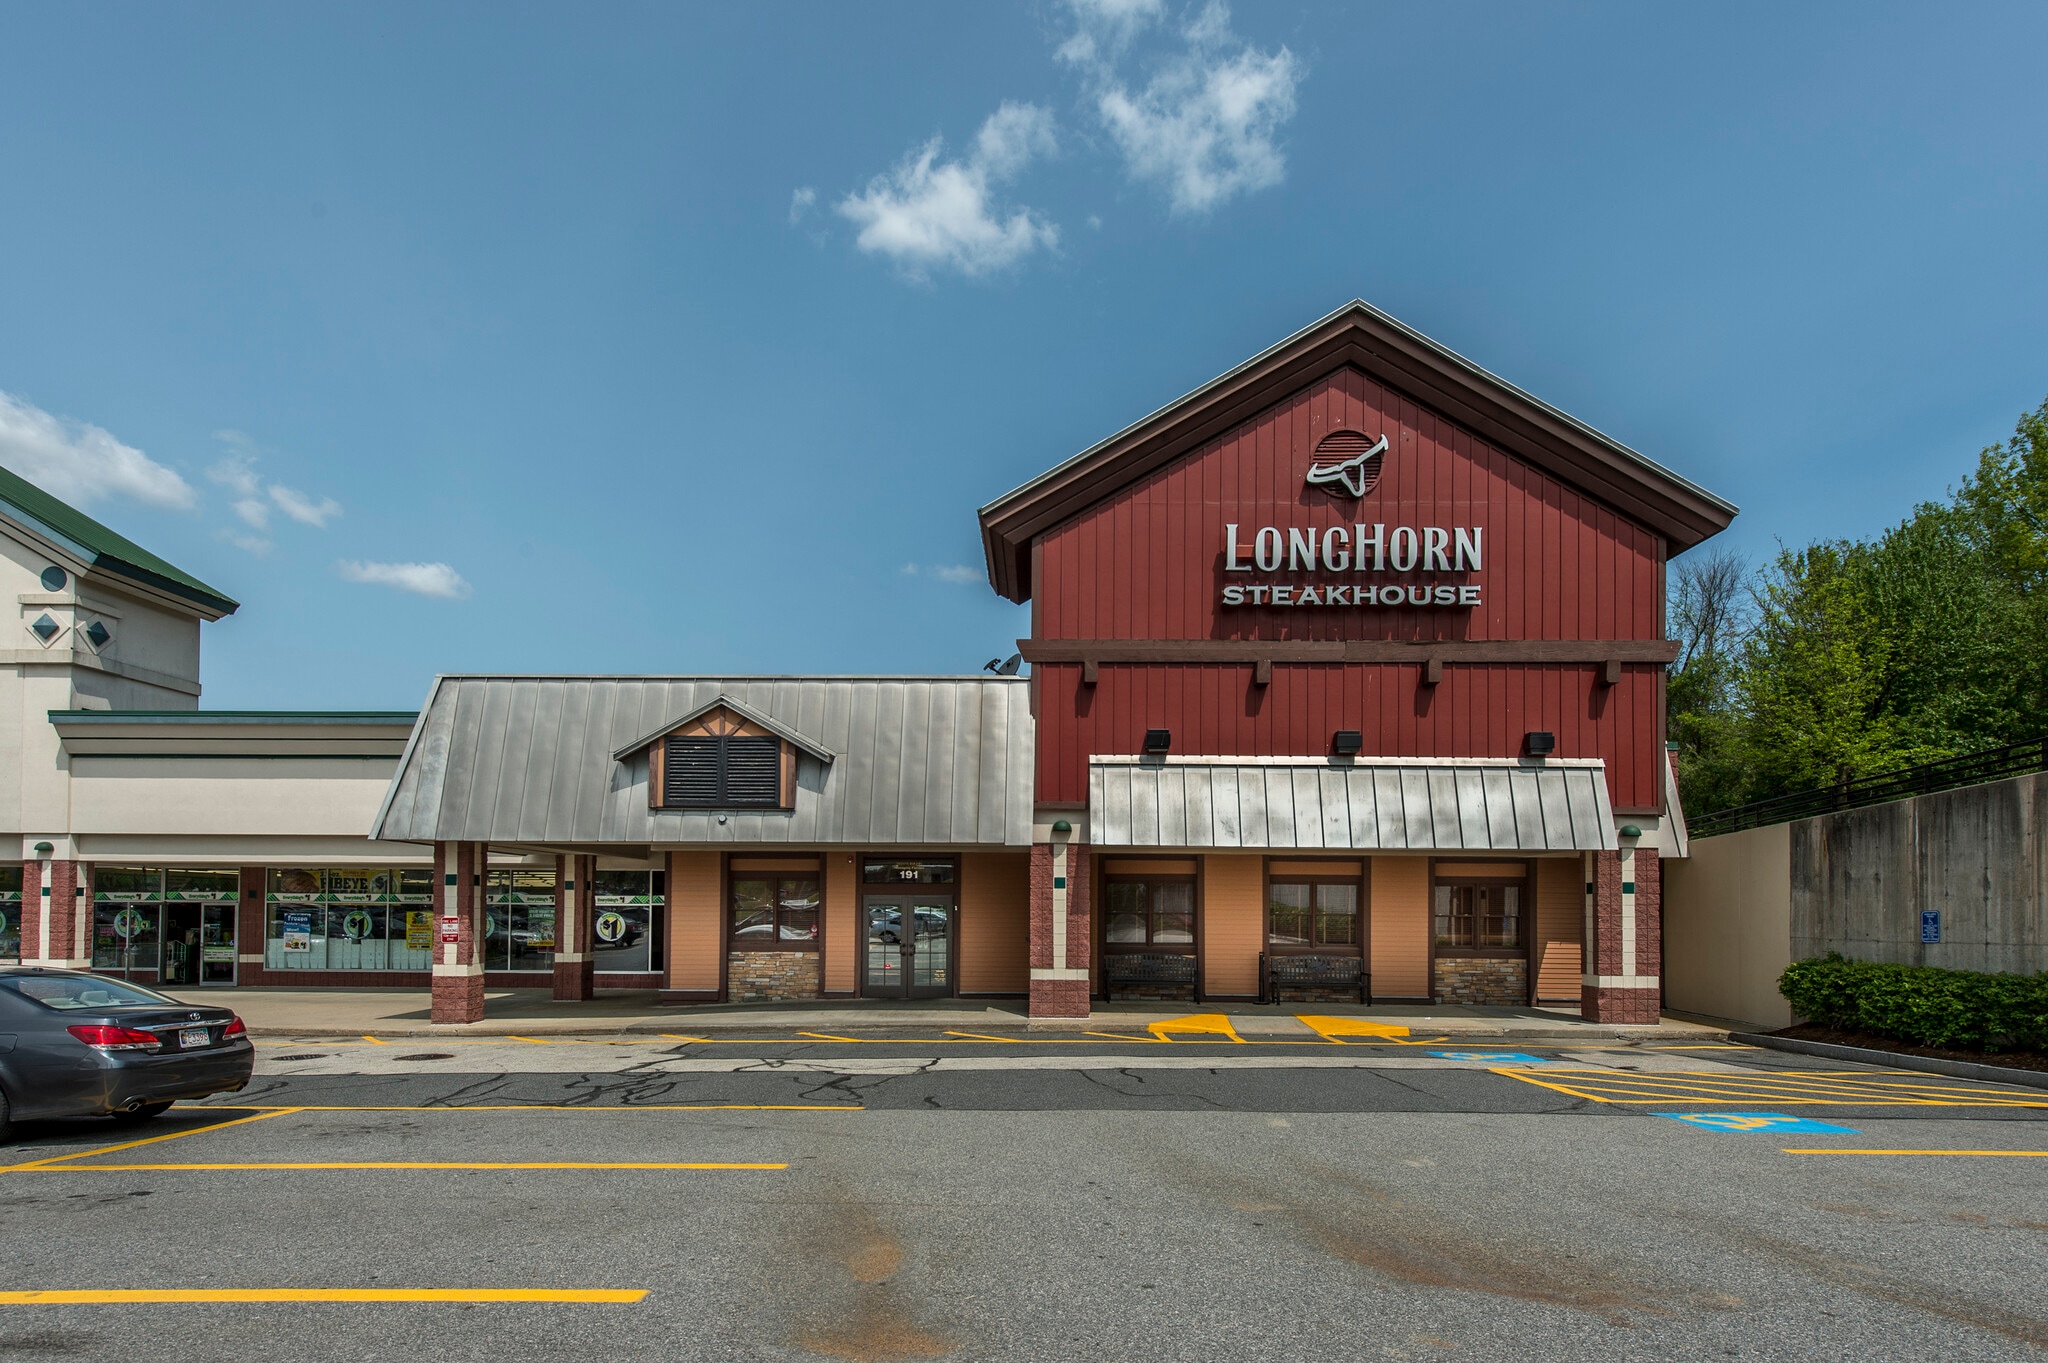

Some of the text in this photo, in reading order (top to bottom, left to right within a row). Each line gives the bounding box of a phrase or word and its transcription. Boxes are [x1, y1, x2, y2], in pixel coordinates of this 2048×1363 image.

[1225, 523, 1483, 572] LONGHORN
[1222, 585, 1483, 606] STEAKHOUSE
[900, 870, 918, 879] 191
[350, 916, 365, 939] $1
[602, 918, 618, 940] $1
